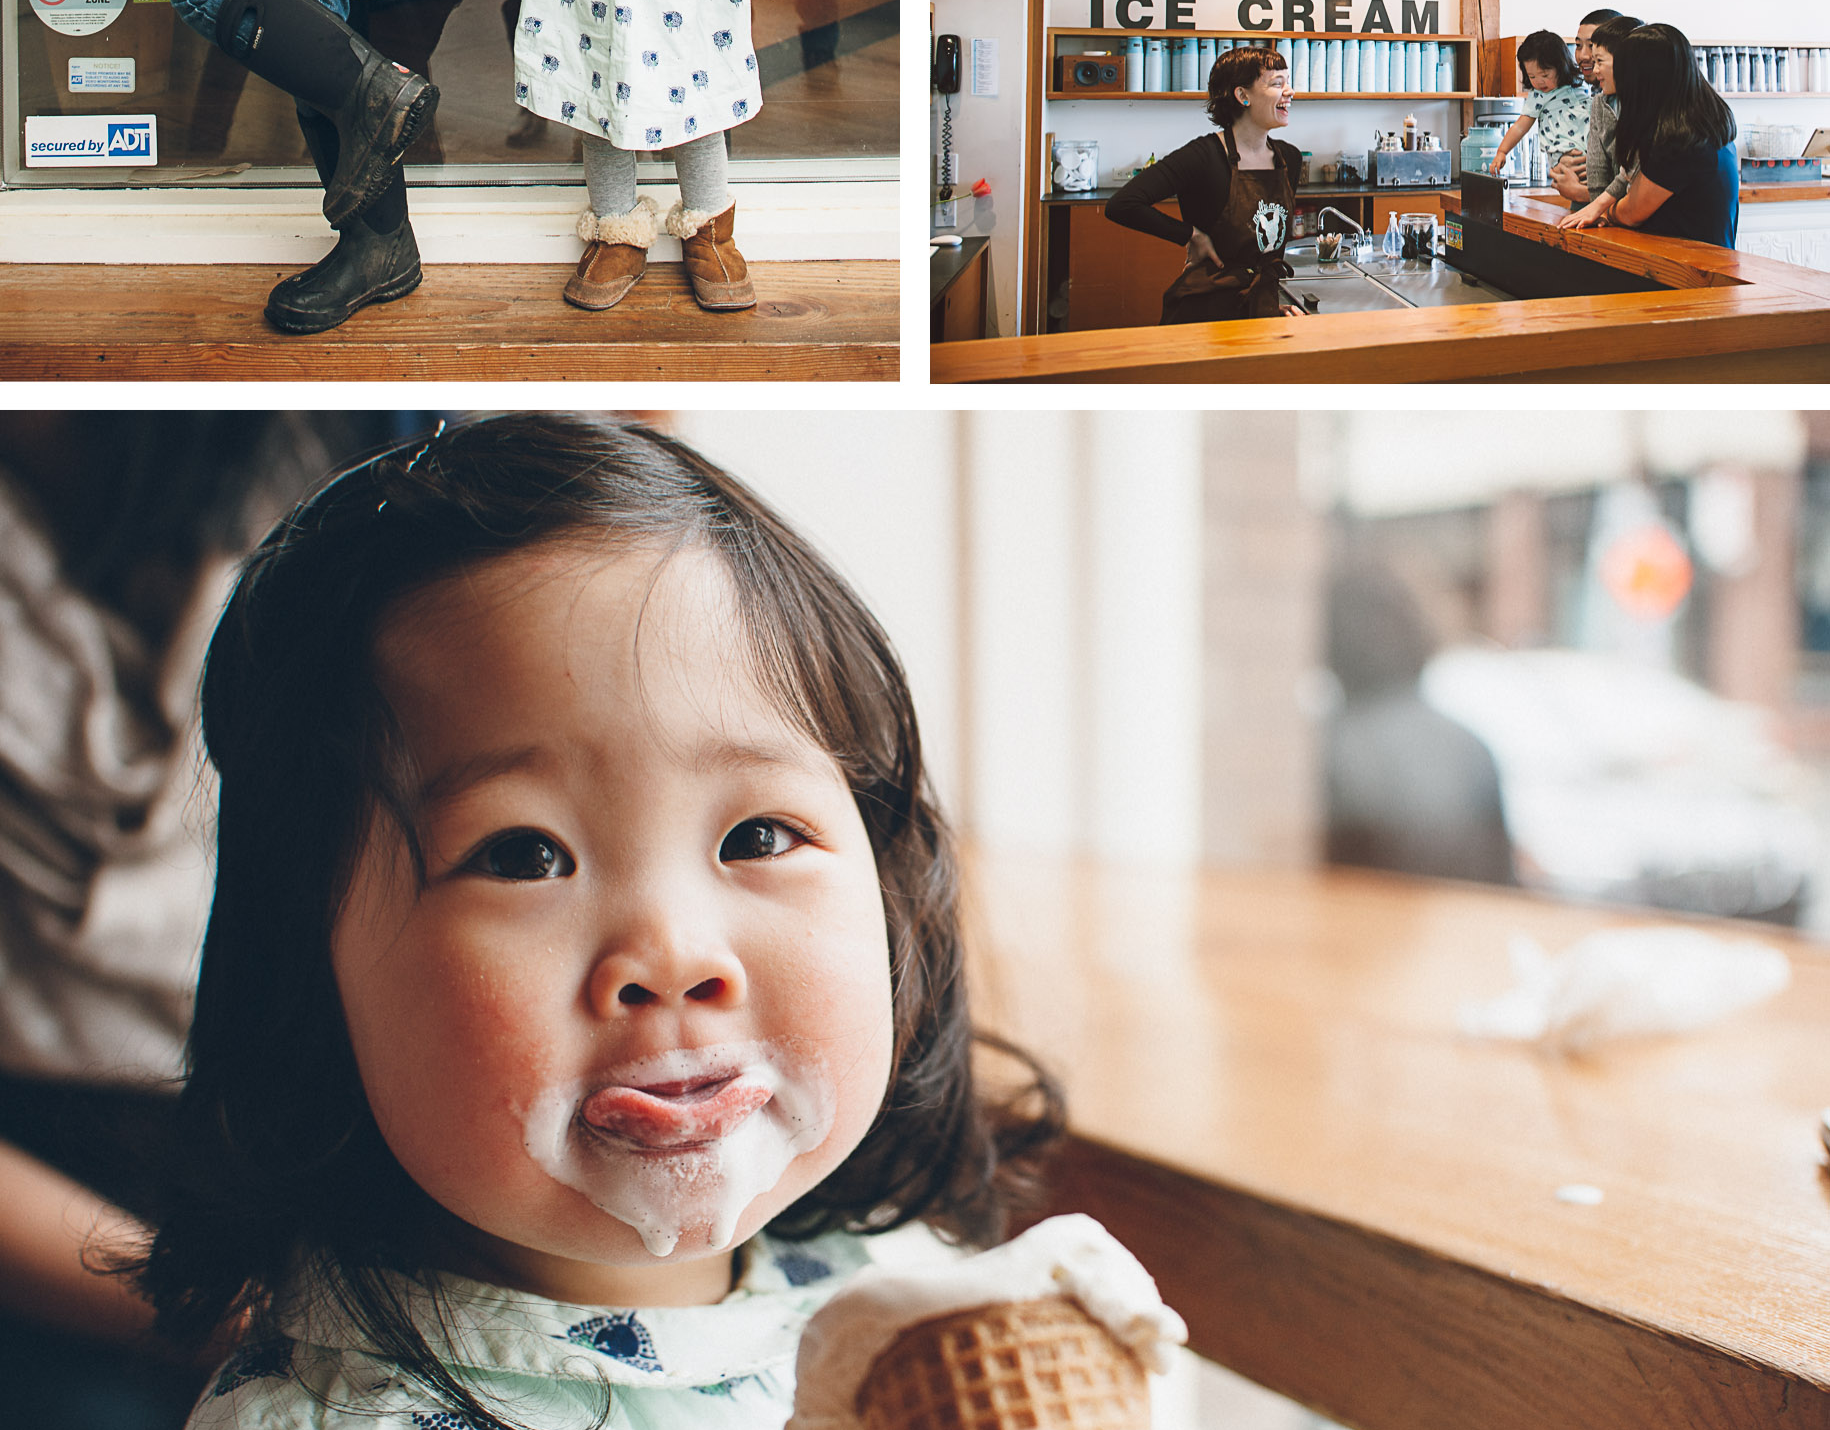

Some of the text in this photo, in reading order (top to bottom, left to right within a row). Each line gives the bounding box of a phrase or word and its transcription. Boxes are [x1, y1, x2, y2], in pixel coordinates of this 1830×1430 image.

[31, 128, 150, 154] secured by ADT
